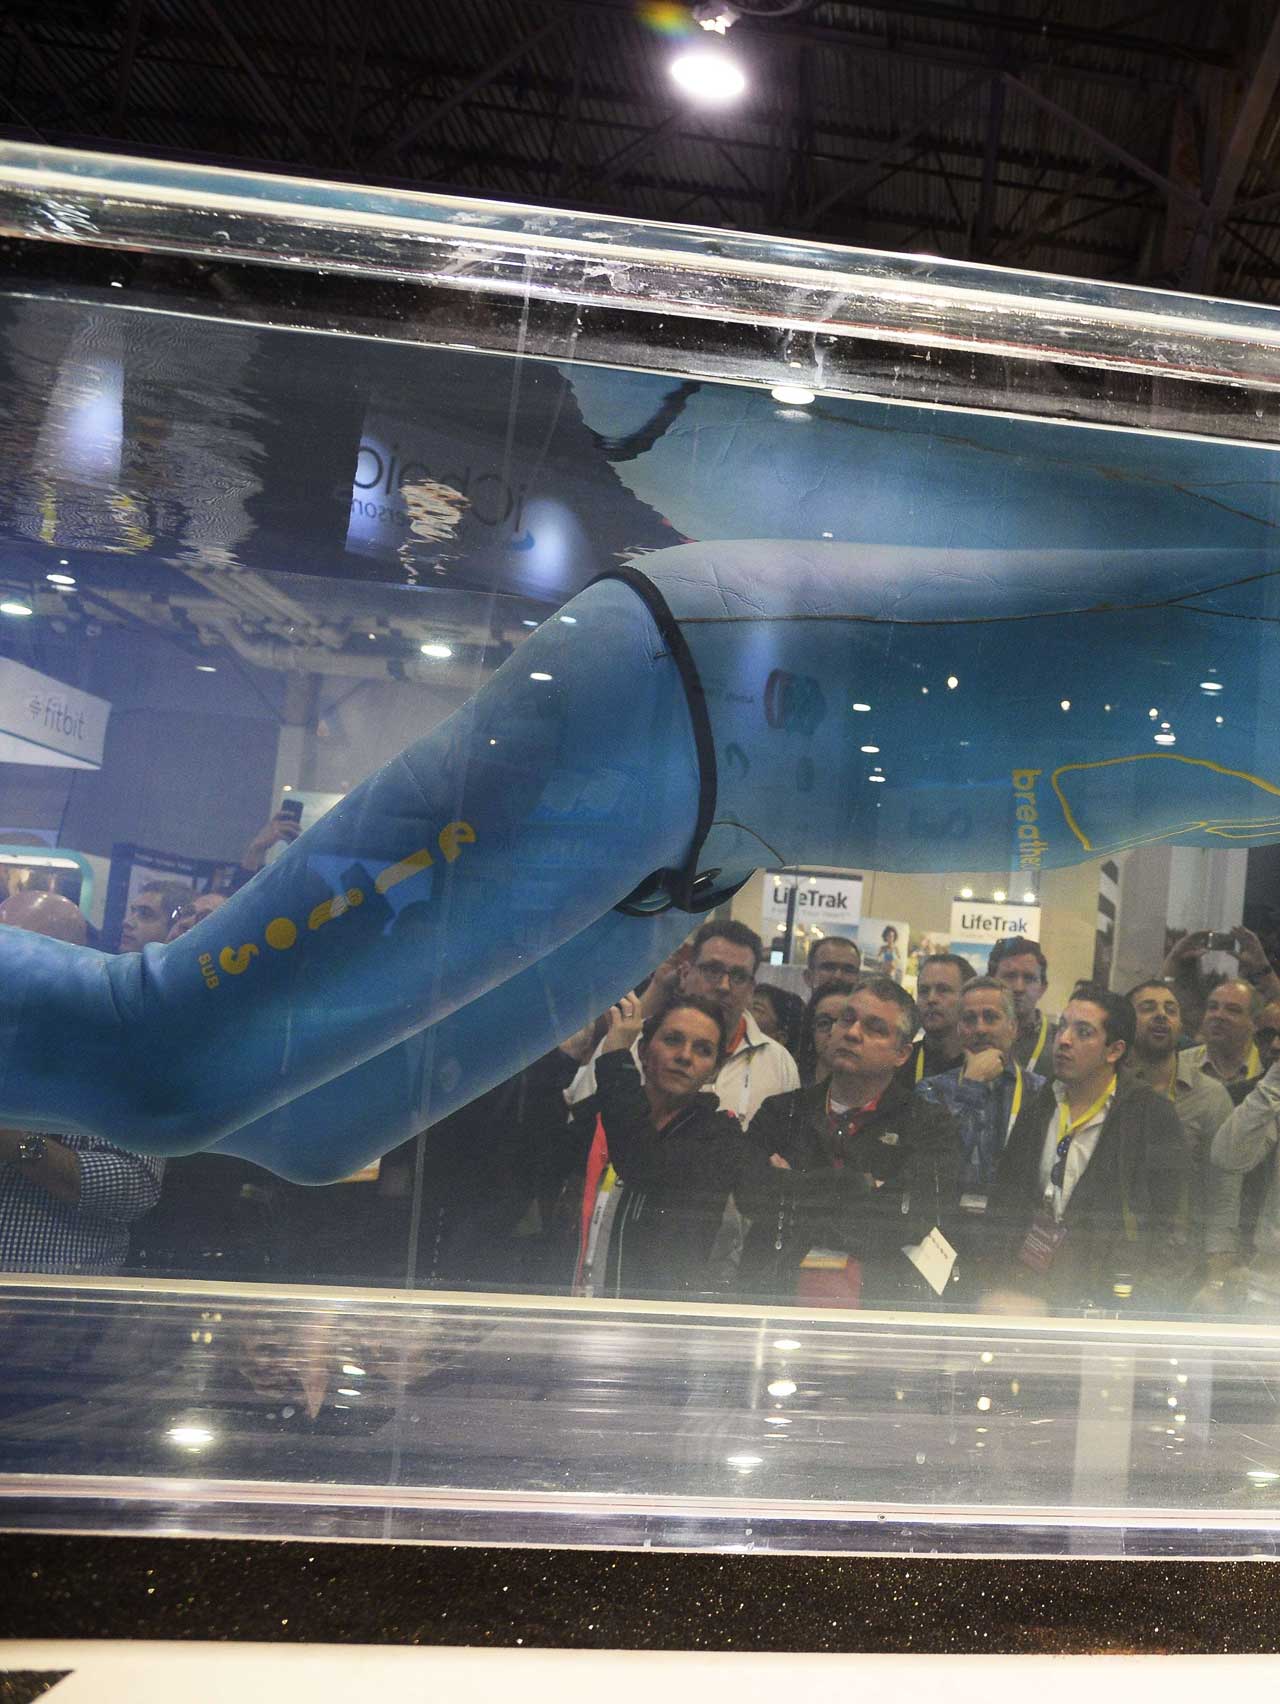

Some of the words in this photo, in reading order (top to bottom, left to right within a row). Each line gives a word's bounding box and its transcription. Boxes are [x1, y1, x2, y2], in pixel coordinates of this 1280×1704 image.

[43, 698, 86, 740] fitbit
[773, 887, 848, 910] LieTrak
[961, 914, 1028, 933] LifeTrak
